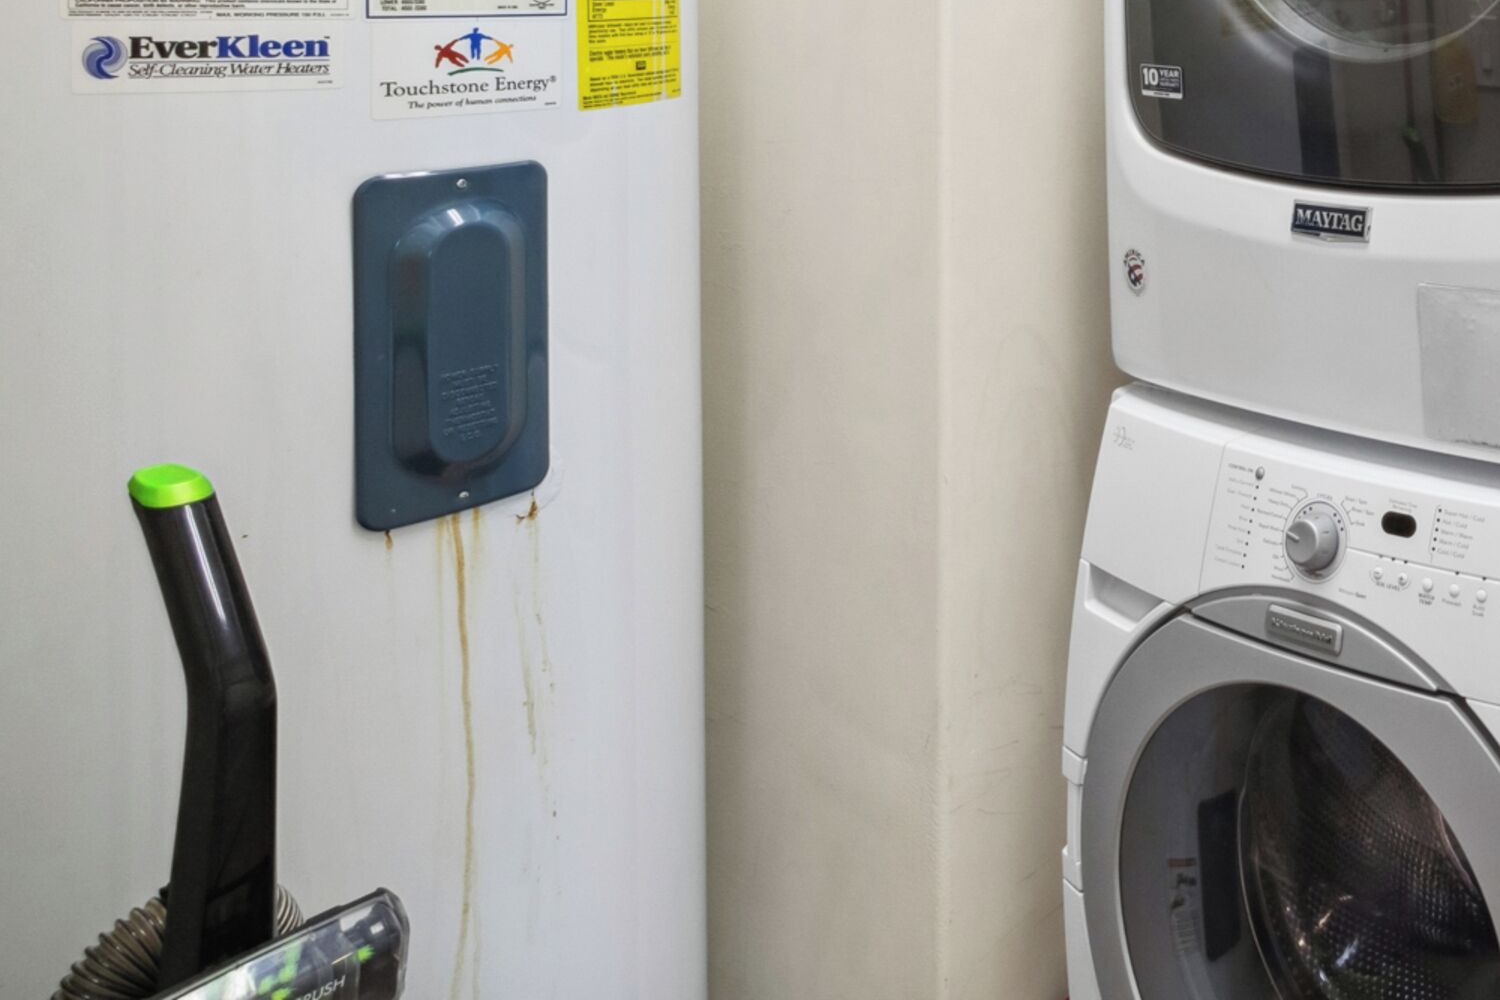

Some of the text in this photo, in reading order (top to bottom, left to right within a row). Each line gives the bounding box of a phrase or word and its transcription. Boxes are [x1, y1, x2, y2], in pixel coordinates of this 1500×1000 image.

[128, 61, 330, 79] Self-Cleaning Water Heaters
[1143, 67, 1180, 86] 10 YEAR
[380, 80, 489, 98] Touchstone
[408, 101, 424, 109] The
[426, 101, 452, 110] power
[454, 98, 465, 107] of
[495, 95, 536, 103] connections
[1295, 208, 1364, 232] MAYTAG
